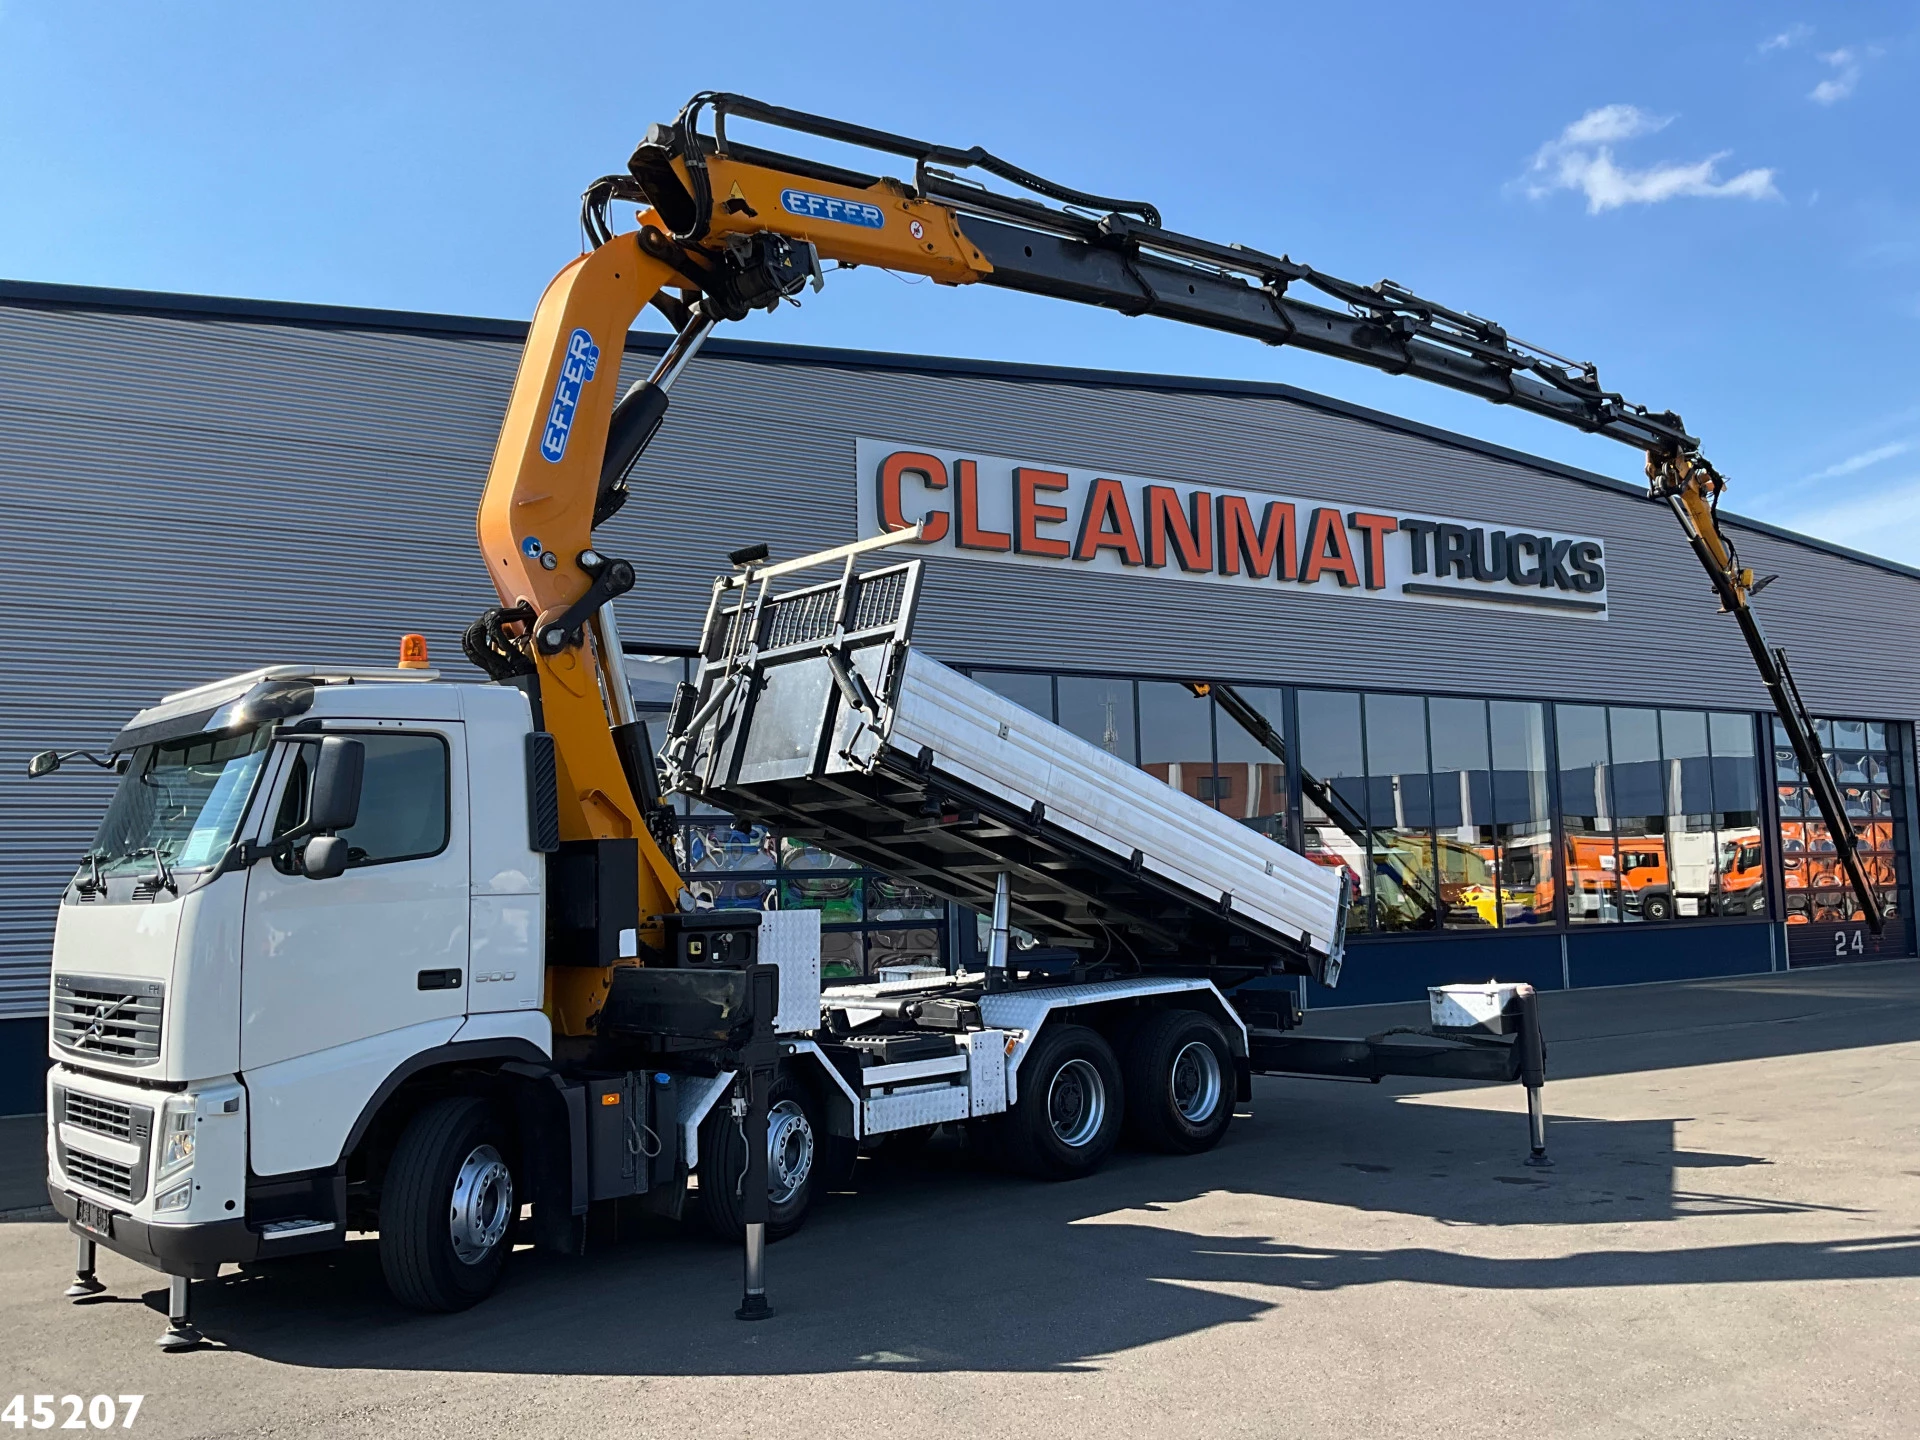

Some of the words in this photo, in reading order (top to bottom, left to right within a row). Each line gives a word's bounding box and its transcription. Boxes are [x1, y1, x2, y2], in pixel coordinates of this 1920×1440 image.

[787, 193, 880, 226] EFFER
[545, 334, 590, 454] EFFER
[876, 451, 1397, 591] CLEANMAT
[1401, 518, 1605, 593] TRUCKS
[1834, 930, 1864, 956] 24
